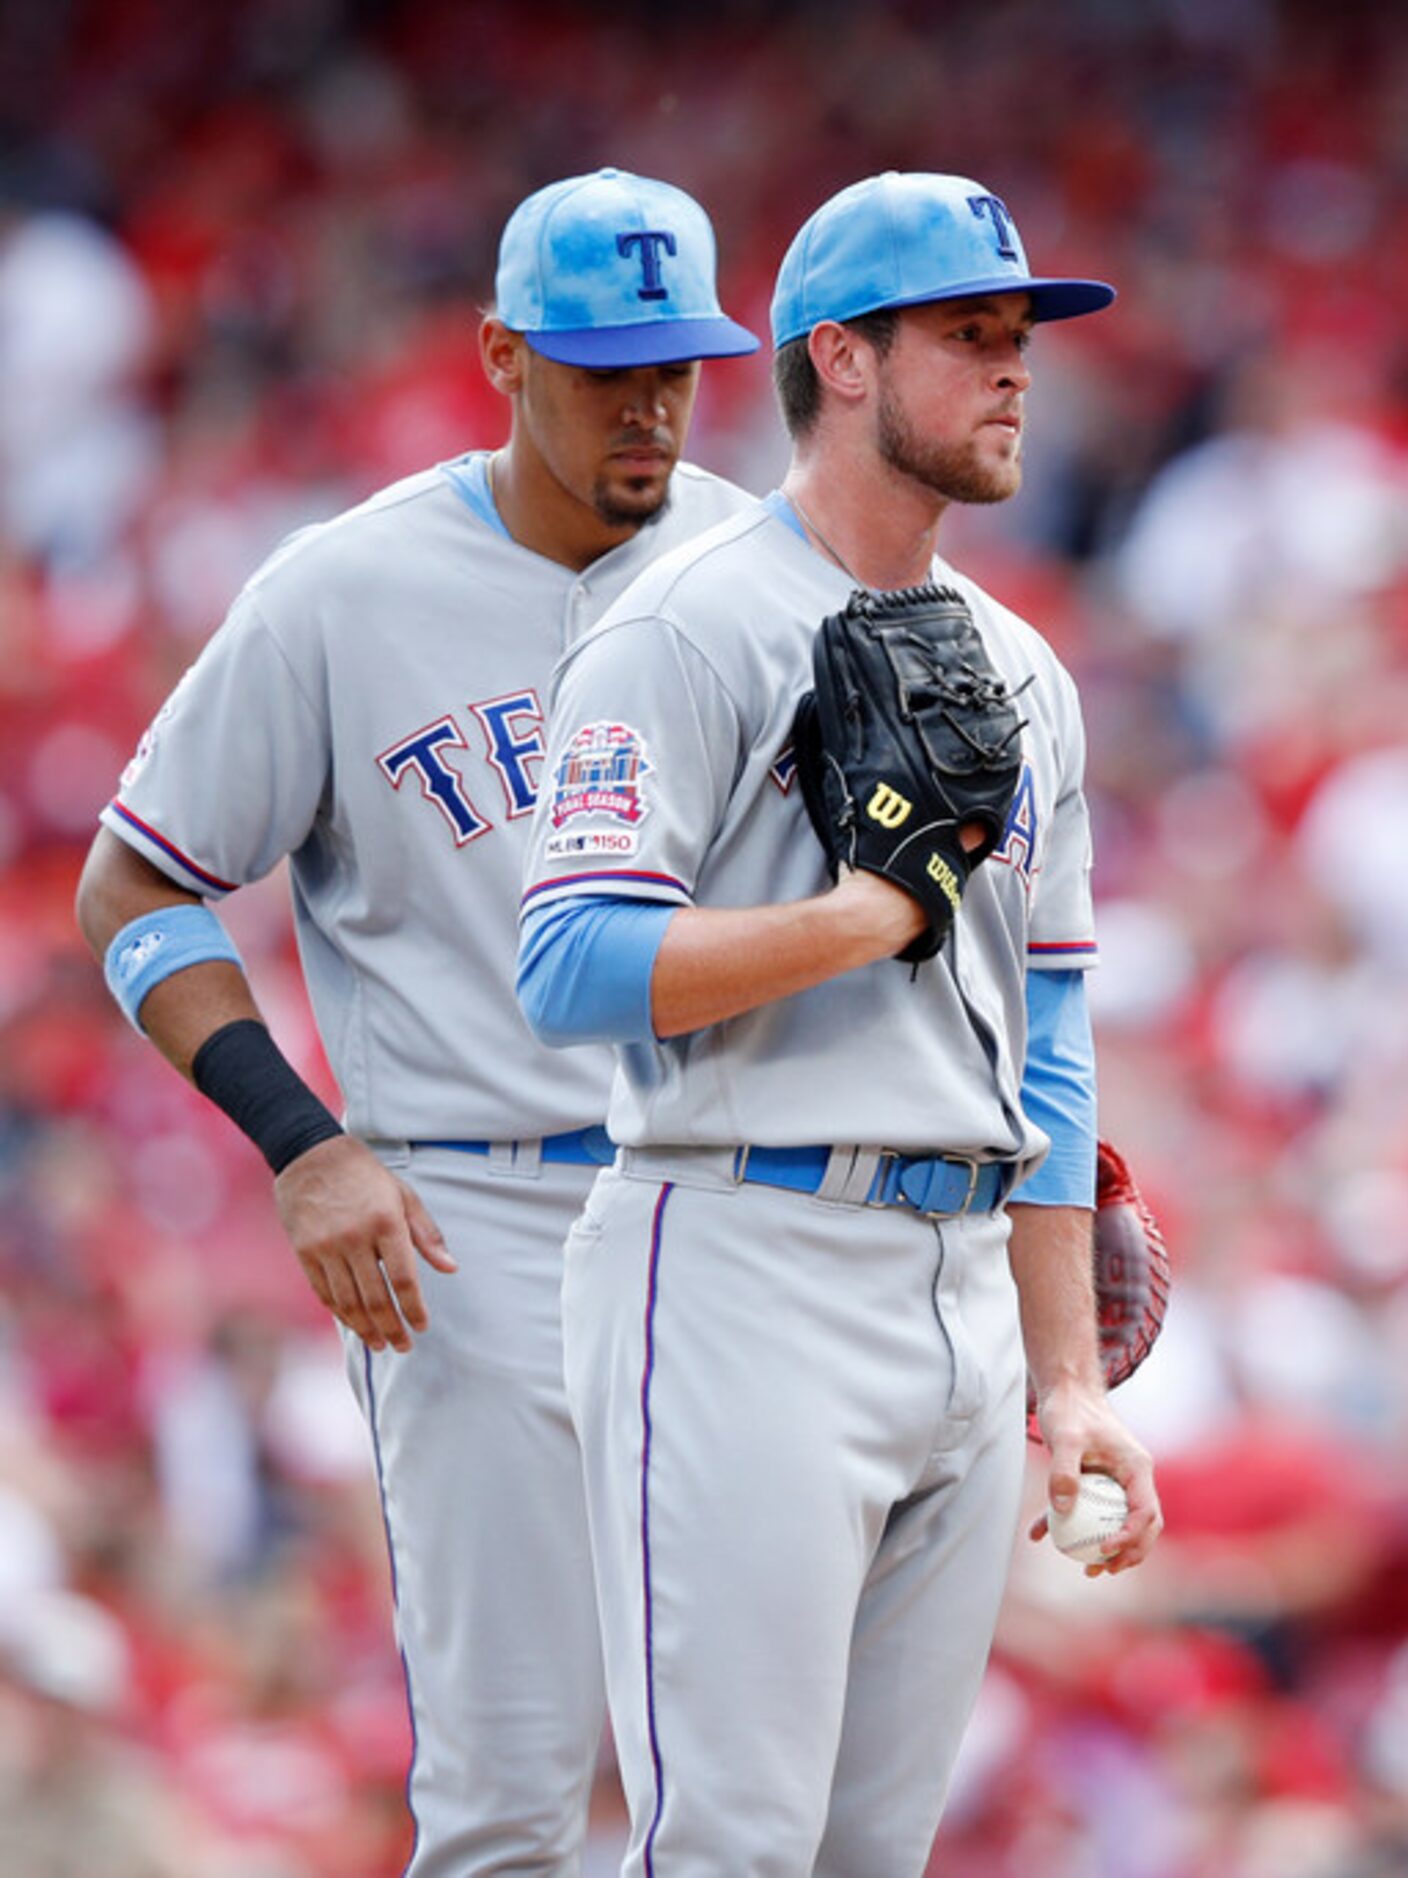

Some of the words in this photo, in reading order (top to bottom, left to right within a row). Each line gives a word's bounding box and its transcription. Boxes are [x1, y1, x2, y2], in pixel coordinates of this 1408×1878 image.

[966, 195, 1018, 263] T
[616, 230, 677, 302] T
[587, 792, 634, 812] SEASON
[866, 781, 912, 830] W
